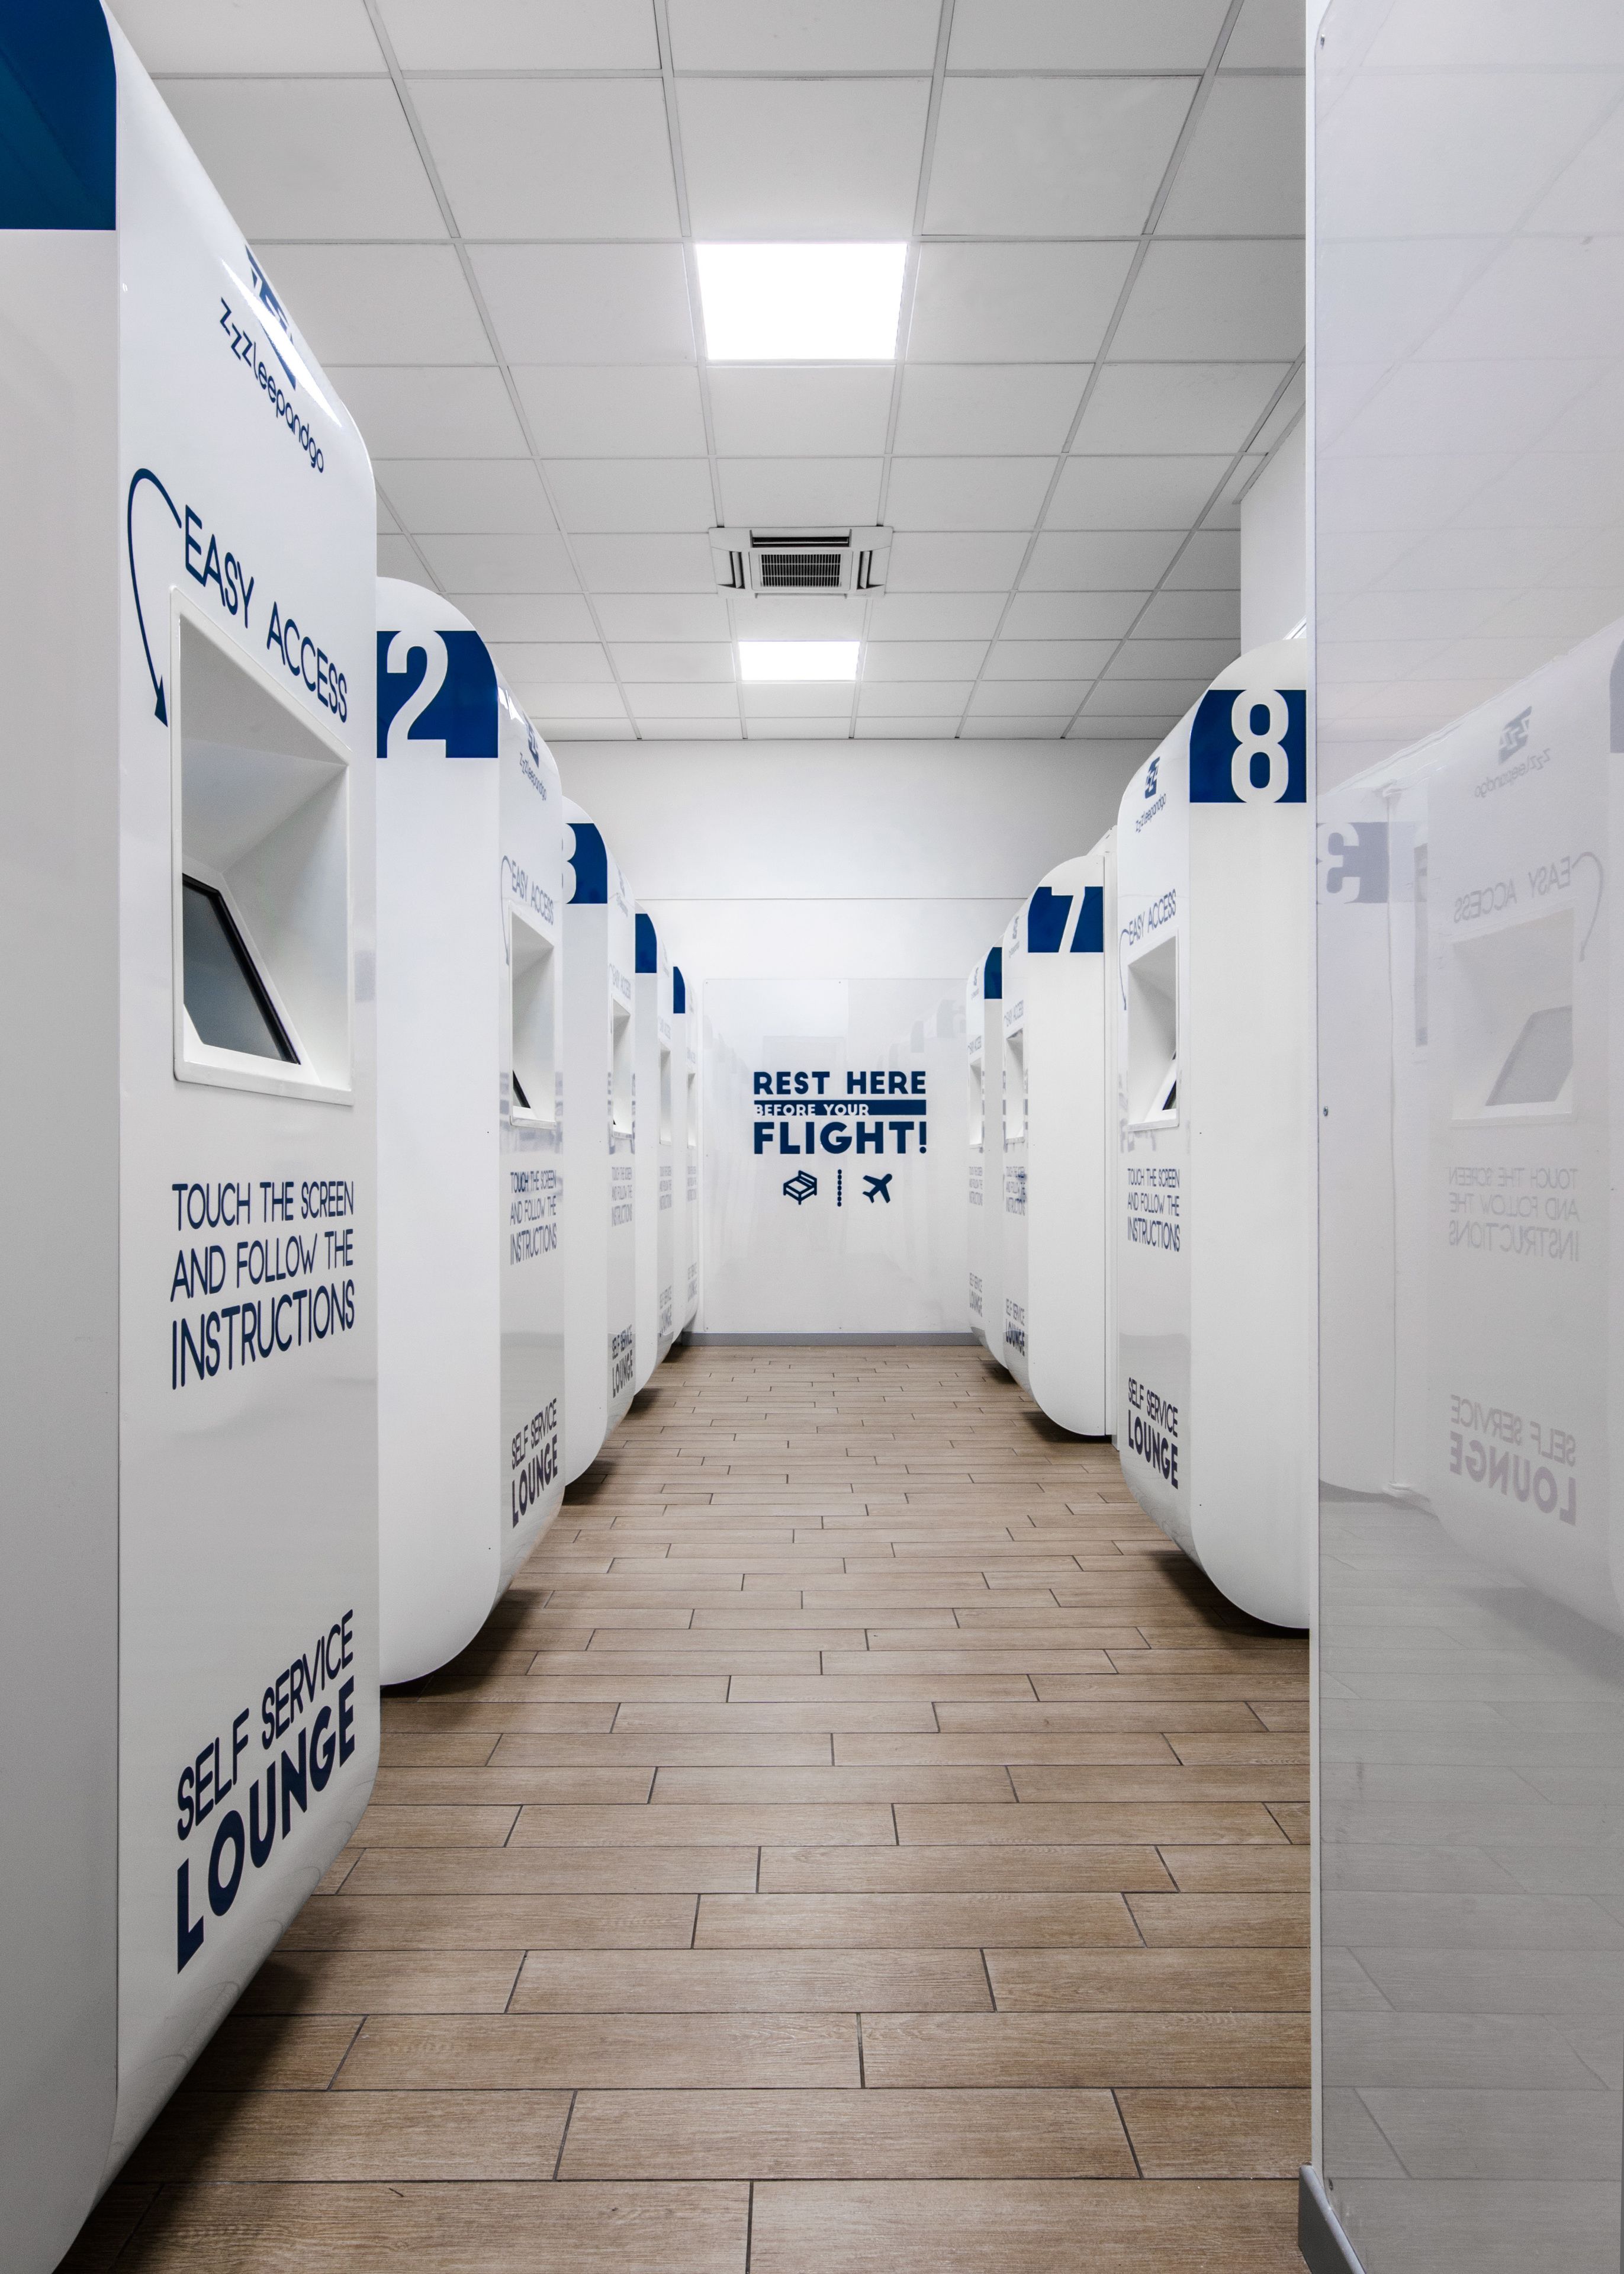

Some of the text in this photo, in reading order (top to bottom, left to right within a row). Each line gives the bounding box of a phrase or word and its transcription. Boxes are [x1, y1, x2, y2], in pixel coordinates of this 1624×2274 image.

[185, 505, 347, 722] EASY ACCESS
[387, 630, 448, 758] 2
[1231, 689, 1289, 803] 8
[512, 860, 554, 926] EASY ACCESS
[1051, 886, 1085, 952] 7
[1129, 889, 1176, 946] EASY ACCESS
[754, 1071, 926, 1094] REST HERE
[754, 1104, 869, 1116] BEFORE YOUR
[754, 1122, 927, 1154] FLIGHT!
[172, 1181, 353, 1231] TOUCH THE SCREEN
[510, 1170, 557, 1193] TOUCH THE SCREEN
[1127, 1168, 1179, 1188] TOUCH THE SCREEN
[1128, 1192, 1179, 1216] AND FOLLOW THE
[510, 1195, 556, 1226] AND FOLLOW THE
[1128, 1216, 1180, 1252] INSTRUCTIONS
[170, 1229, 353, 1302] AND FOLLOW THE
[510, 1222, 557, 1266] INSTRUCTIONS
[172, 1279, 354, 1390] INSTRUCTIONS
[612, 1350, 633, 1398] LOUNGE
[512, 1398, 557, 1470] SELF SERVICE
[1128, 1377, 1178, 1437] SELF SERVICE
[1128, 1409, 1178, 1489] LOUNGE
[512, 1434, 558, 1528] LOUNGE
[177, 1609, 353, 1841] SELF SERVICE
[177, 1675, 355, 1974] LOUNGE
